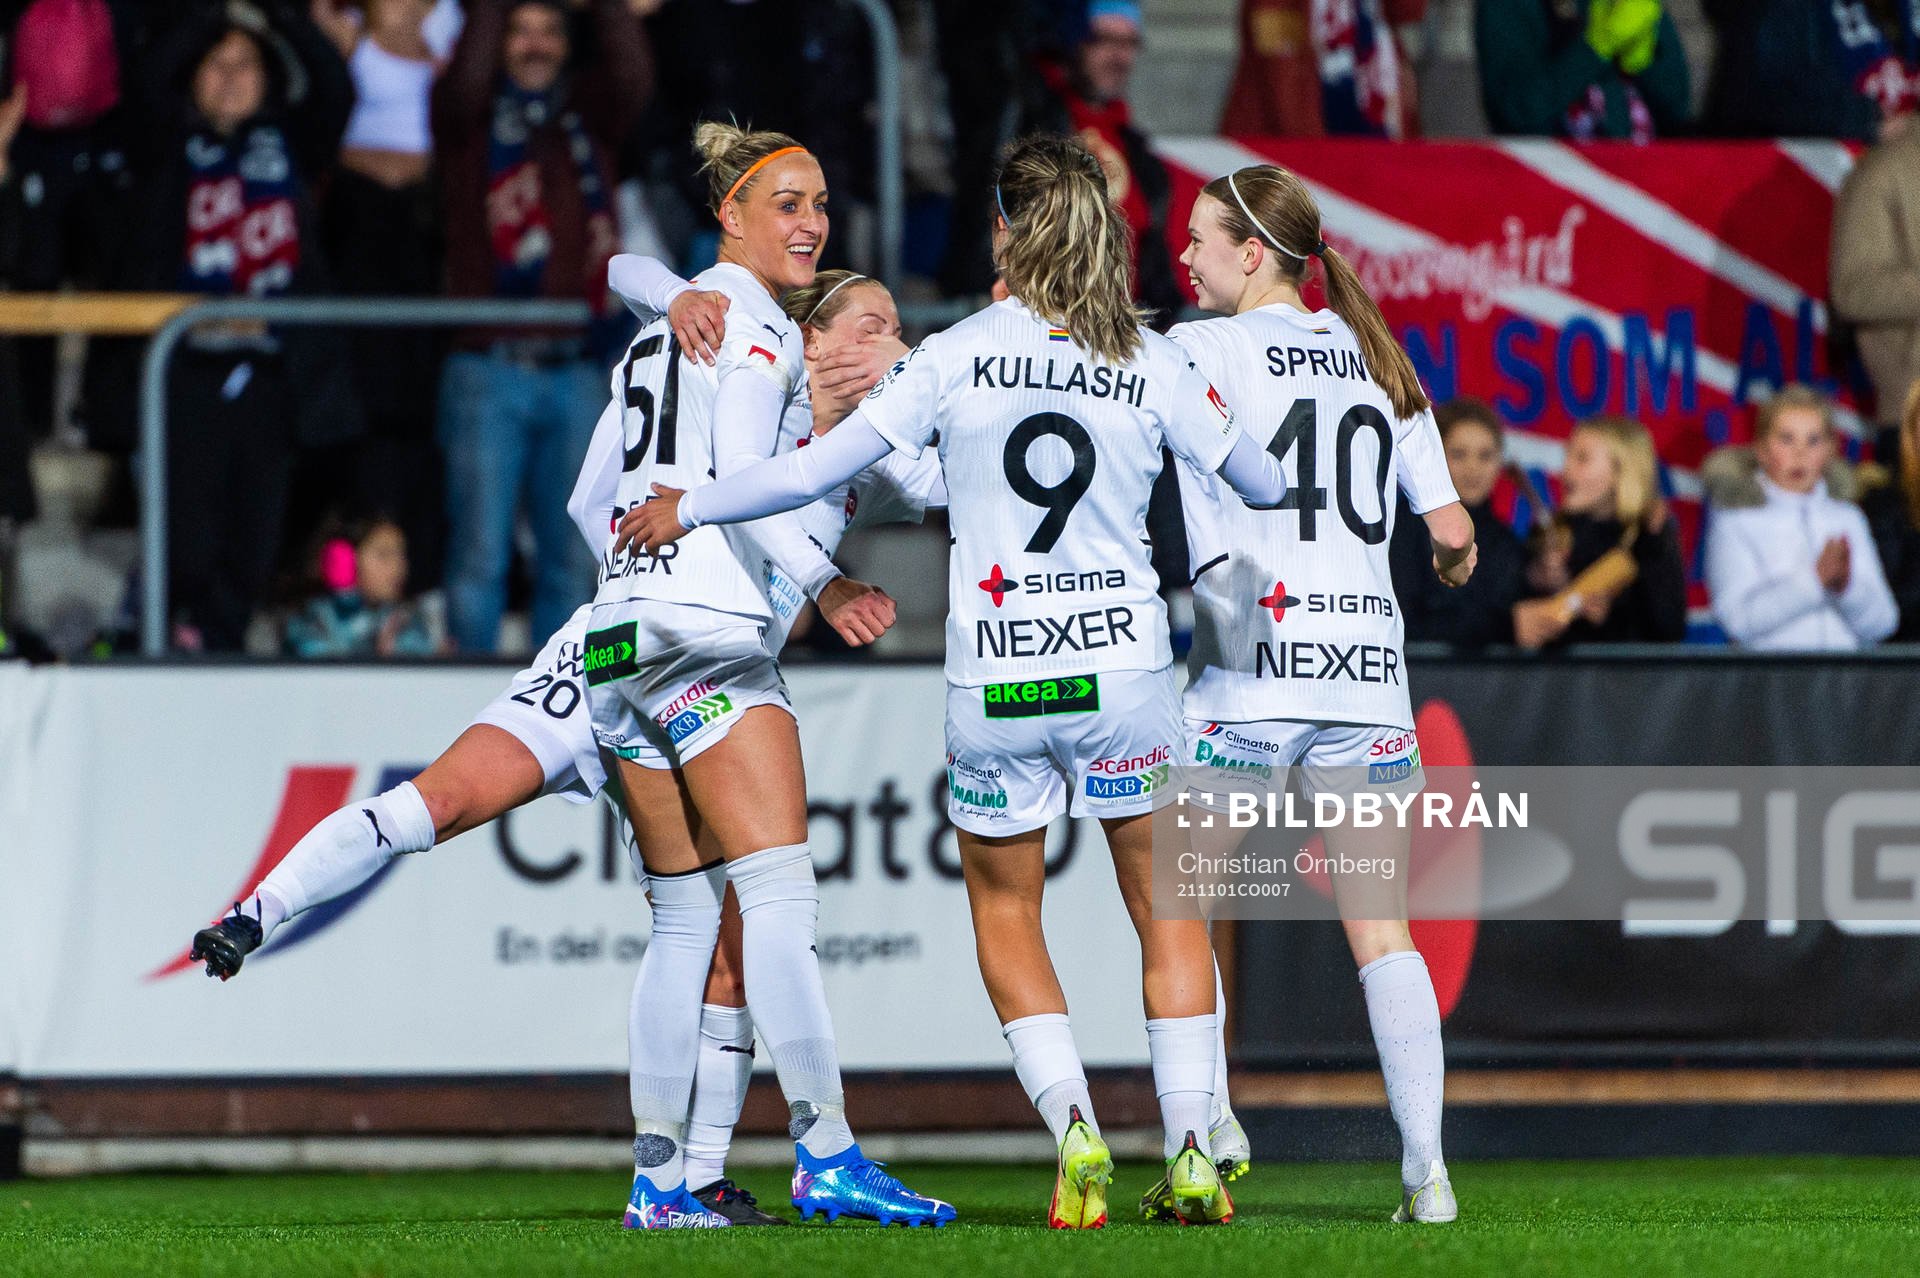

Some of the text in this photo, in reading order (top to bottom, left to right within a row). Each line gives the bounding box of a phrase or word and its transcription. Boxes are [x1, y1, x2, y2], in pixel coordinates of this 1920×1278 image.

[974, 356, 1146, 408] KULLASHI
[622, 332, 682, 473] 51
[1003, 411, 1097, 554] 9
[1245, 398, 1393, 546] 40
[584, 644, 616, 672] akea
[510, 673, 582, 720] 20
[986, 680, 1060, 704] akea
[1225, 730, 1280, 754] Climat80
[956, 759, 1003, 780] Climat80
[1088, 744, 1172, 775] Scandic
[1210, 754, 1273, 781] MALMÖ
[1374, 761, 1409, 782] MKB
[954, 787, 1008, 810] MALMÖ
[1092, 779, 1137, 797] MKB
